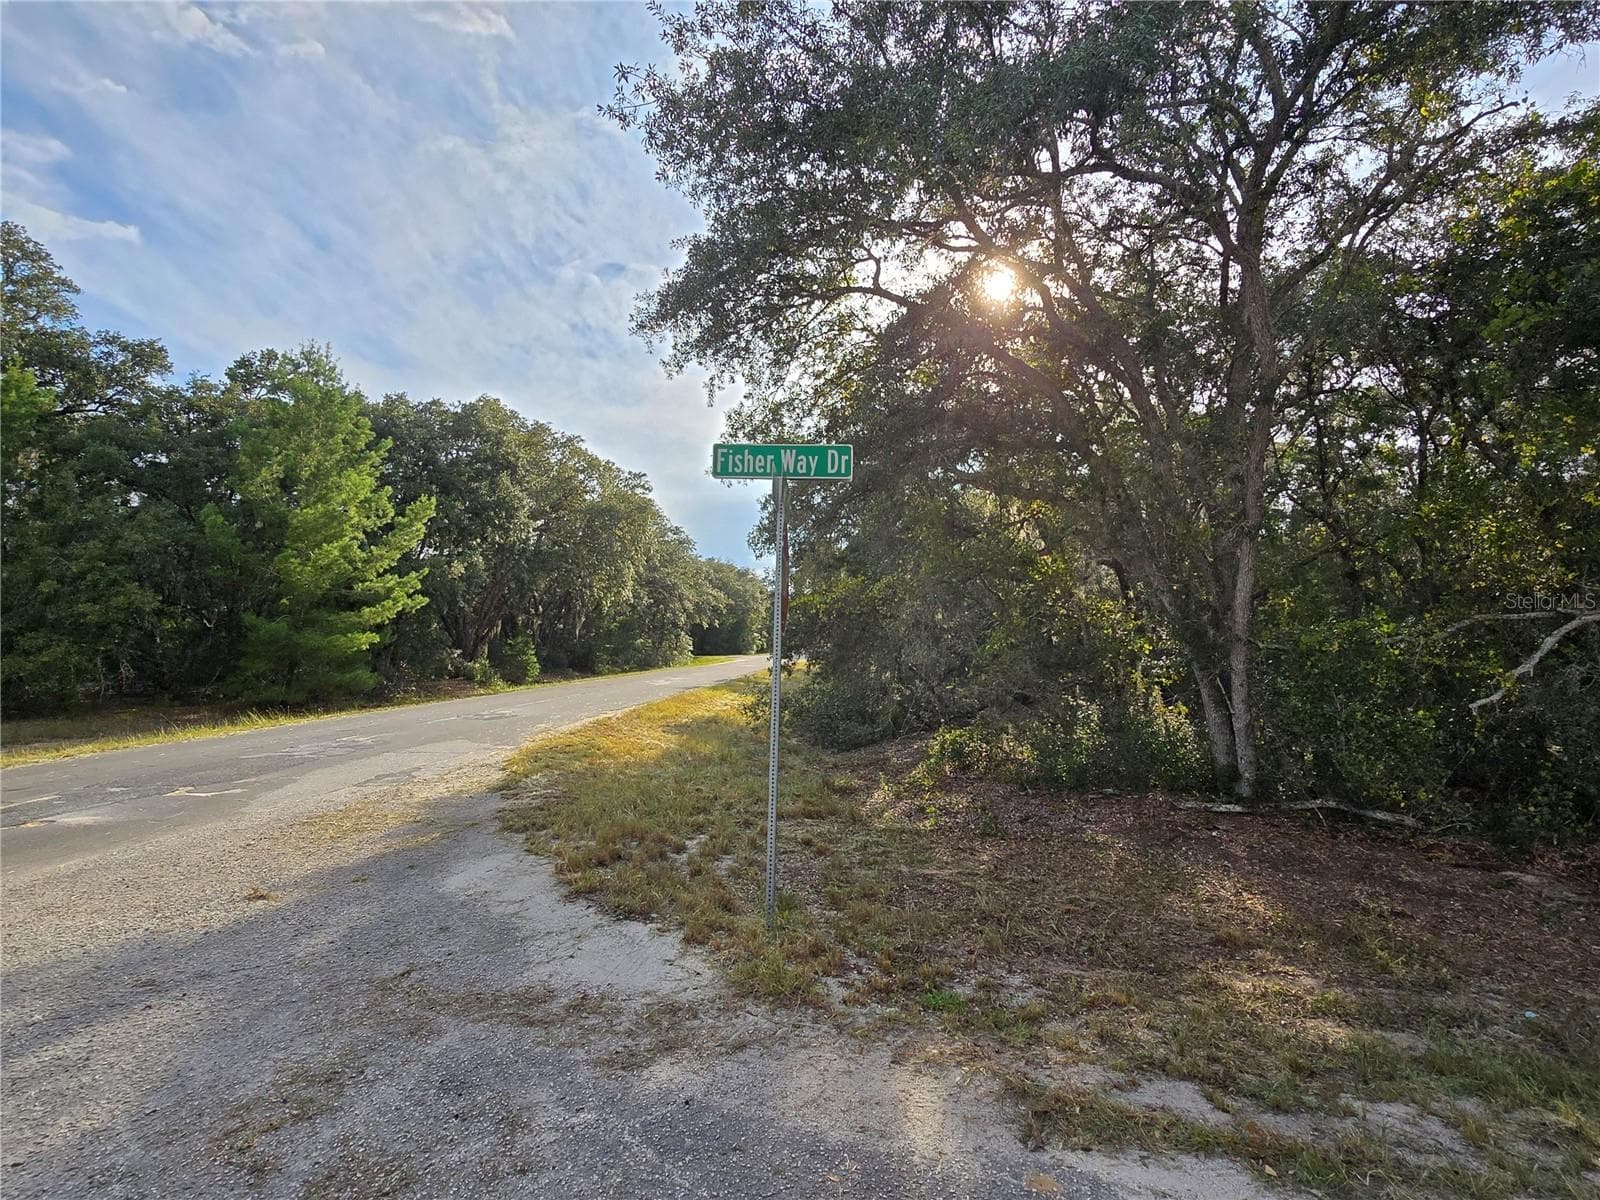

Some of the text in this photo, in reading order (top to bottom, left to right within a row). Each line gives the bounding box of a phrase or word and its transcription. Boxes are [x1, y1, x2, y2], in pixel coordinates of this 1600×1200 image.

[716, 448, 848, 476] Fisher Way Dr
